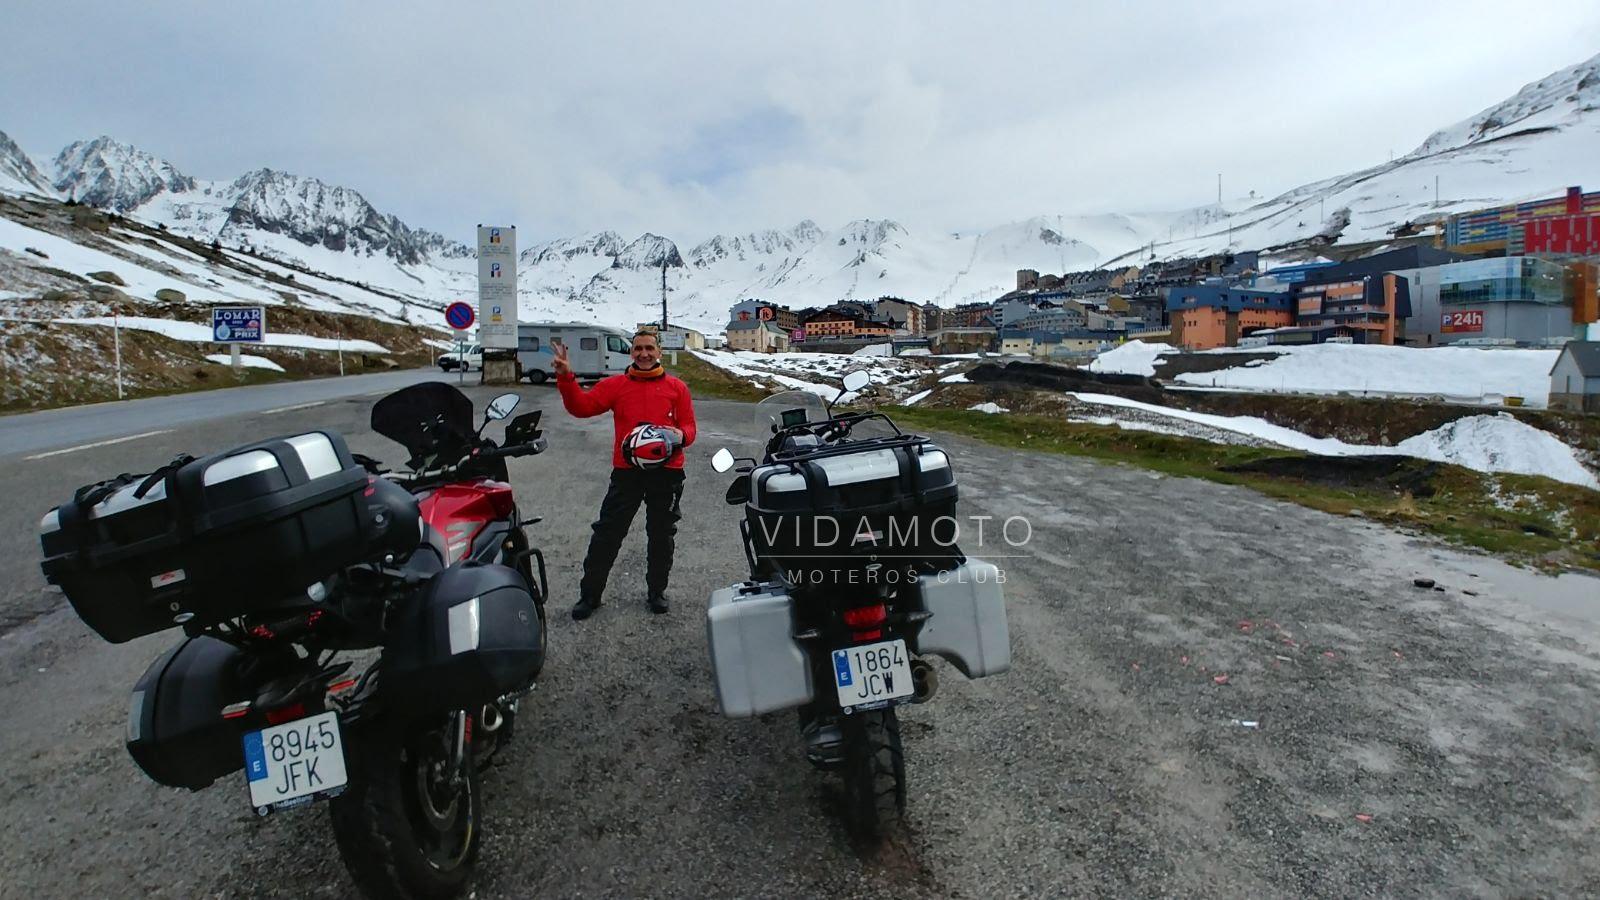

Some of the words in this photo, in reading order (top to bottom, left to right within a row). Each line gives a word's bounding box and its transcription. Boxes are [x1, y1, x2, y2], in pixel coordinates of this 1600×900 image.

[215, 309, 260, 320] LOMAR
[1454, 312, 1482, 326] 24h
[855, 646, 904, 674] 1864
[840, 671, 848, 680] E
[858, 671, 894, 698] JCW
[270, 720, 335, 762] 8945
[253, 760, 261, 772] E
[276, 756, 323, 794] JFK
